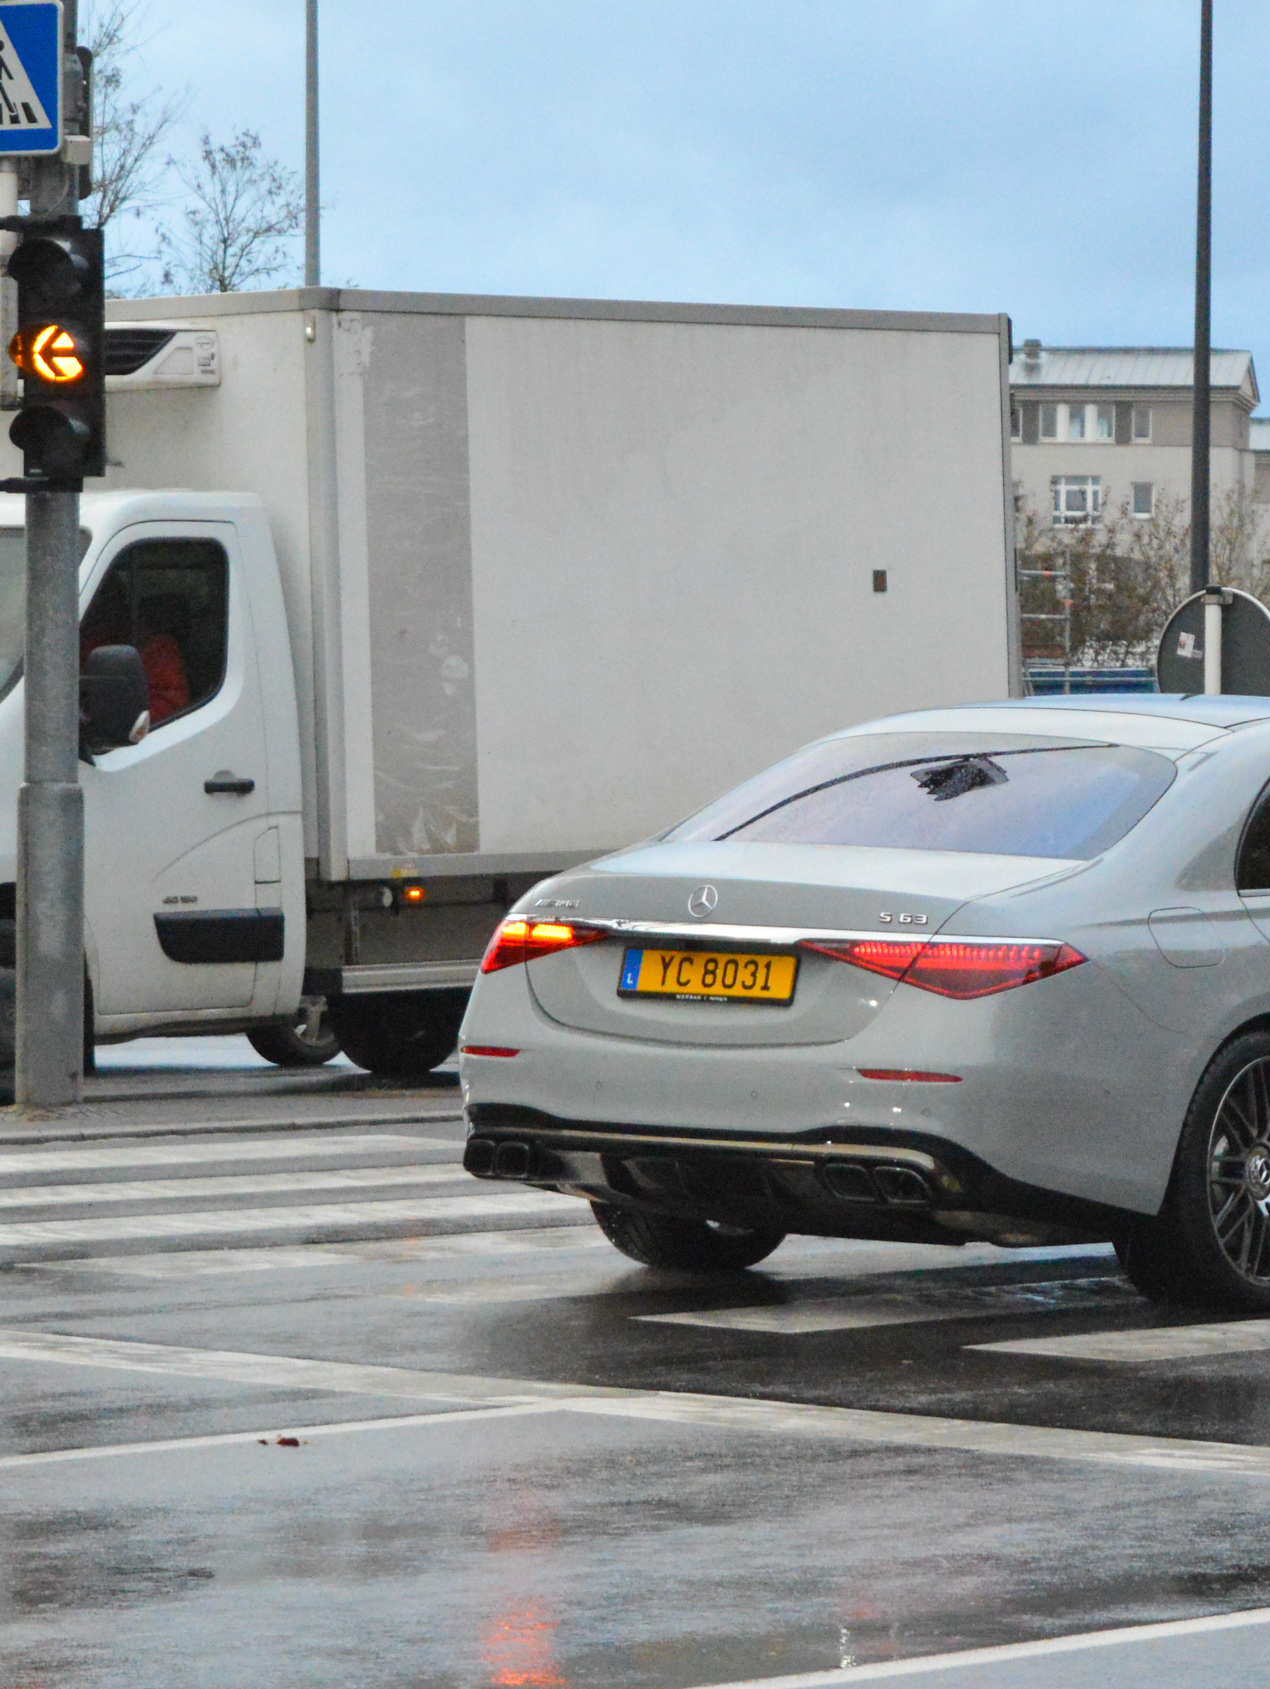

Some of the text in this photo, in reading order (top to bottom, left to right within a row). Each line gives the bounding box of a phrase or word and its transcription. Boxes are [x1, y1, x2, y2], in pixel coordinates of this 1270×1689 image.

[879, 911, 928, 925] S 63
[626, 954, 773, 991] L YC 8031
